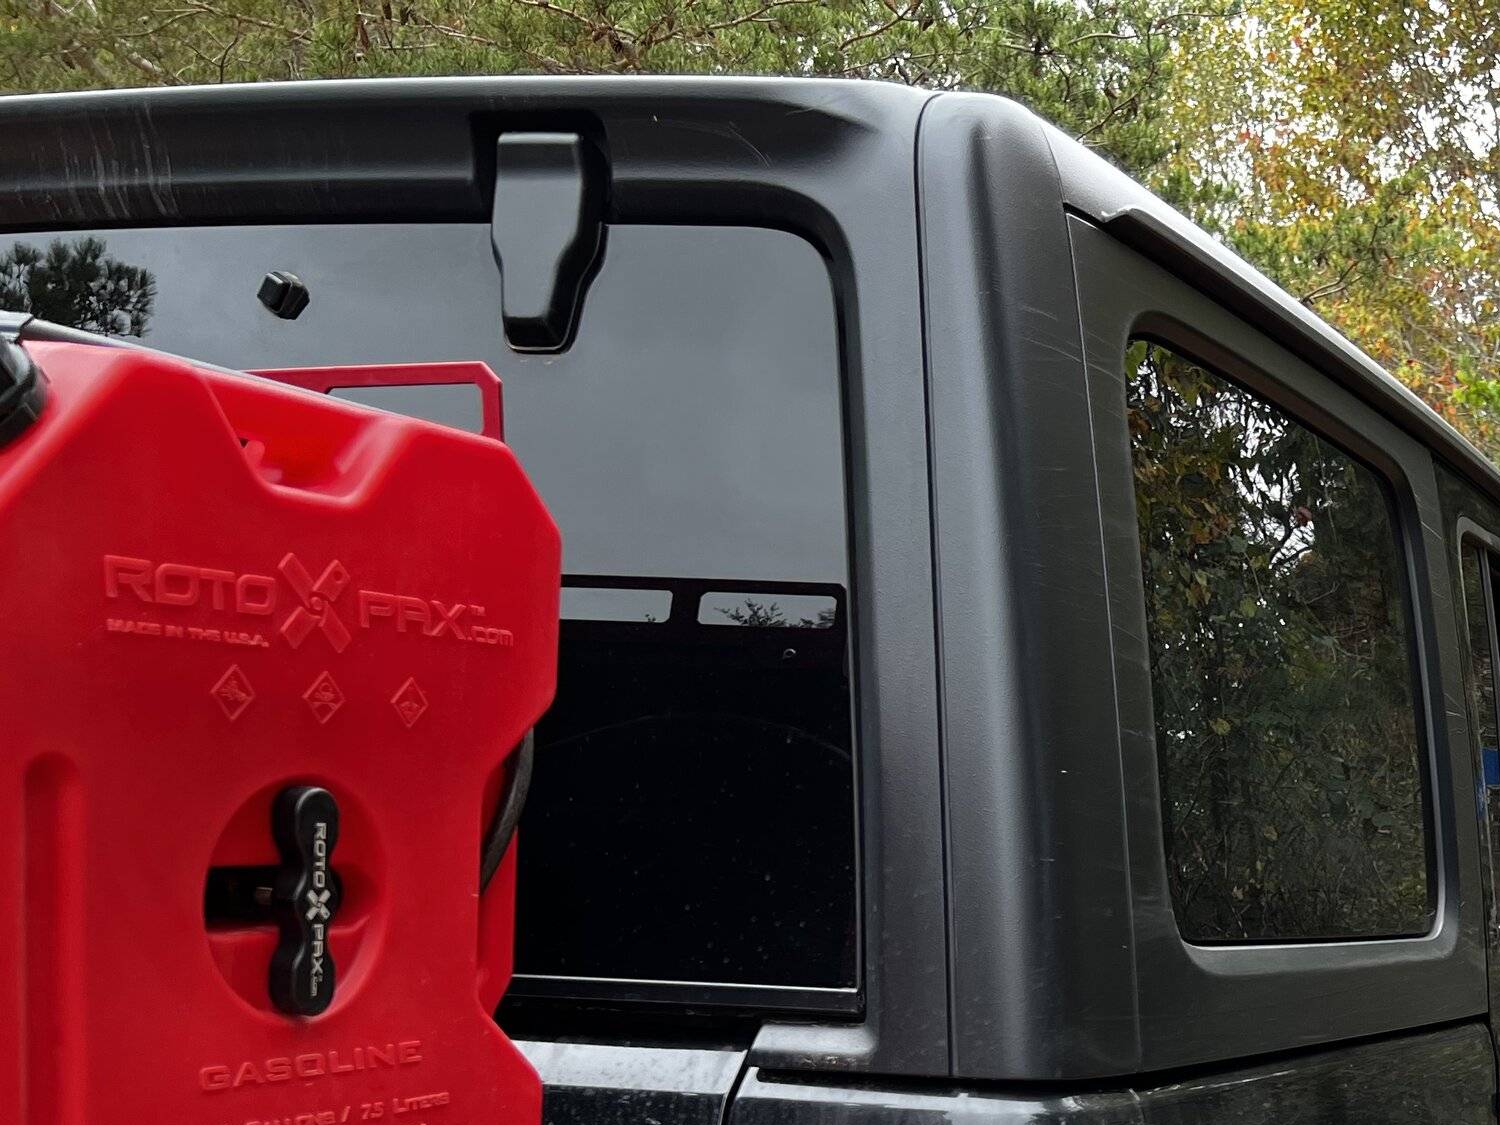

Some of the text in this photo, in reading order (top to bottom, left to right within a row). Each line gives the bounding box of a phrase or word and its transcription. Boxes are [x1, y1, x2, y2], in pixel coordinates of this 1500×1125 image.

[103, 553, 277, 617] ROTO
[311, 822, 328, 888] ROTO
[200, 1040, 423, 1091] GASOLINE
